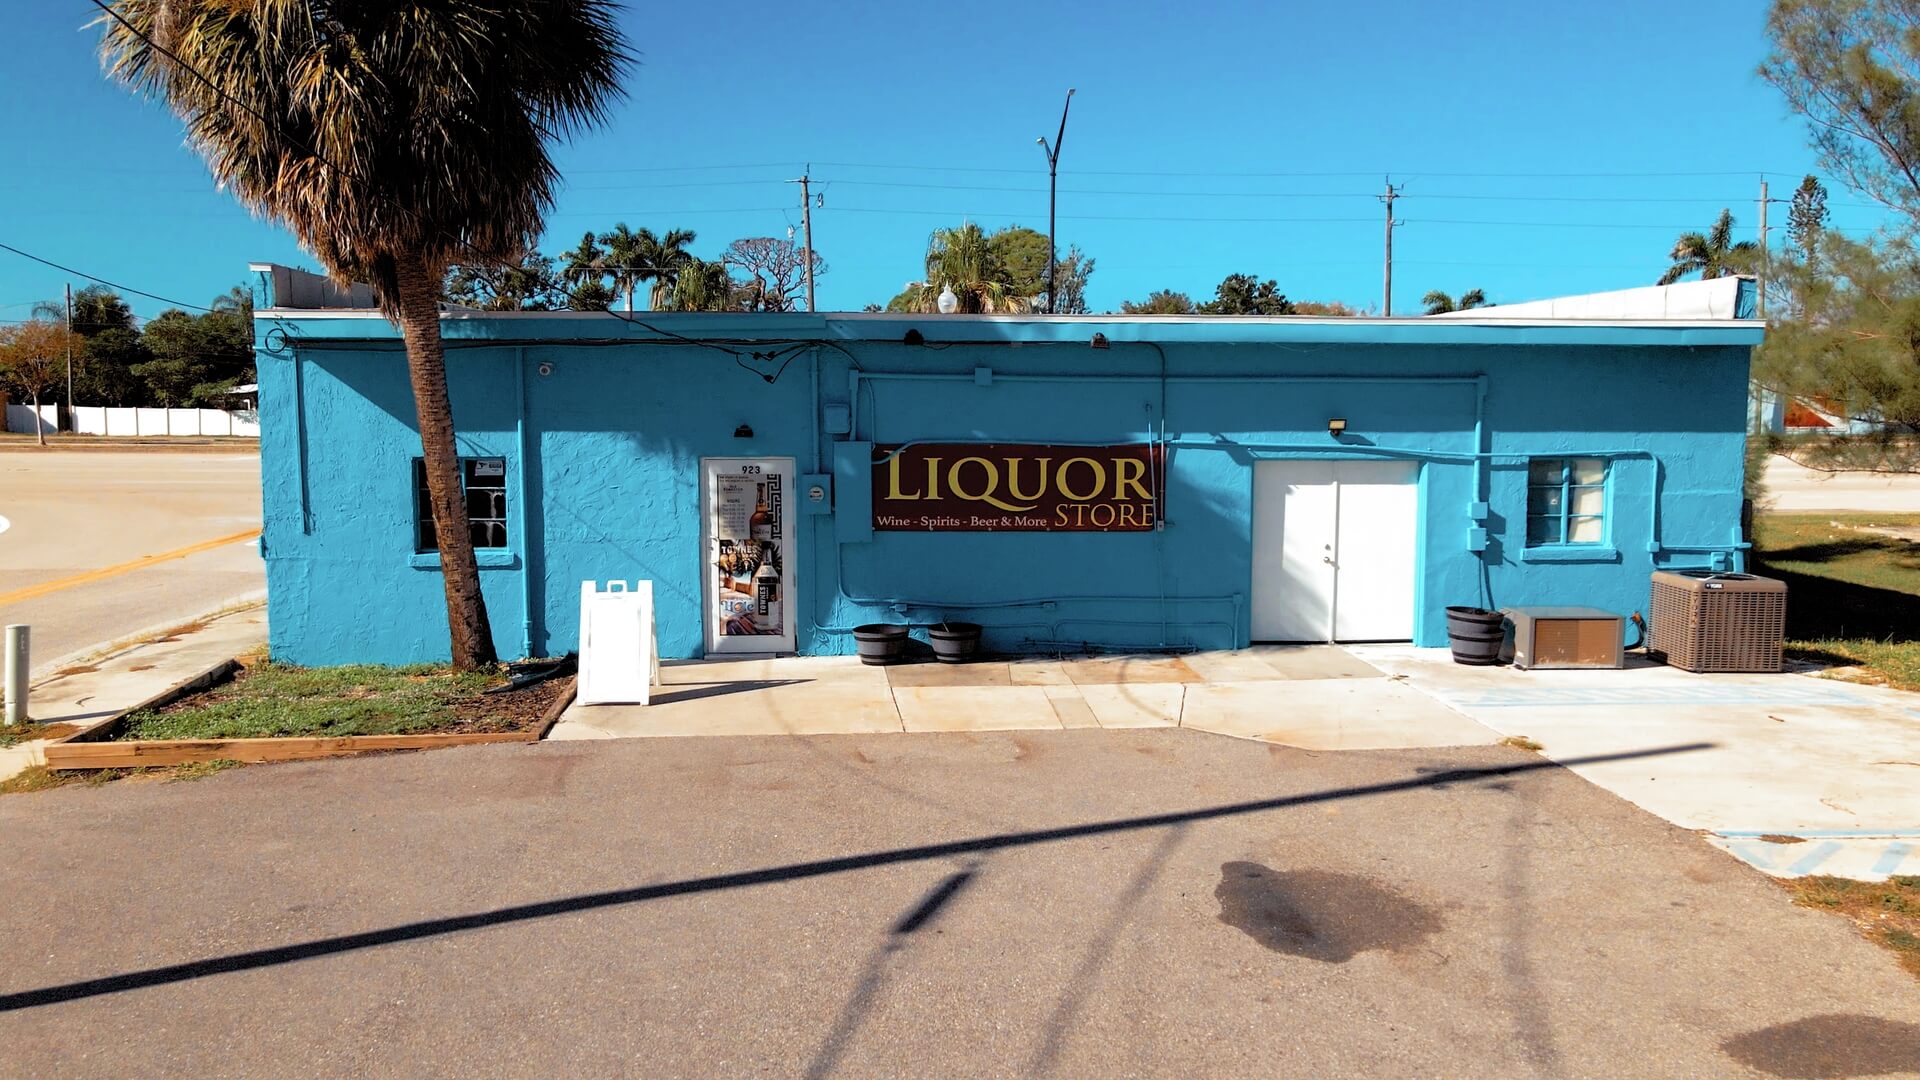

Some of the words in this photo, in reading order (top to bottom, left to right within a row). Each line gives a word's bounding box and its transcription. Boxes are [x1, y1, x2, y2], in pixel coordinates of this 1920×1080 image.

[742, 465, 761, 474] 923
[884, 450, 1156, 512] LIQUOR
[877, 515, 911, 526] Wine
[920, 515, 961, 531] Spirits
[970, 516, 999, 527] Beer
[1000, 516, 1012, 527] &
[1014, 516, 1047, 527] More
[1055, 503, 1154, 527] STORE
[721, 545, 758, 554] TOWNES
